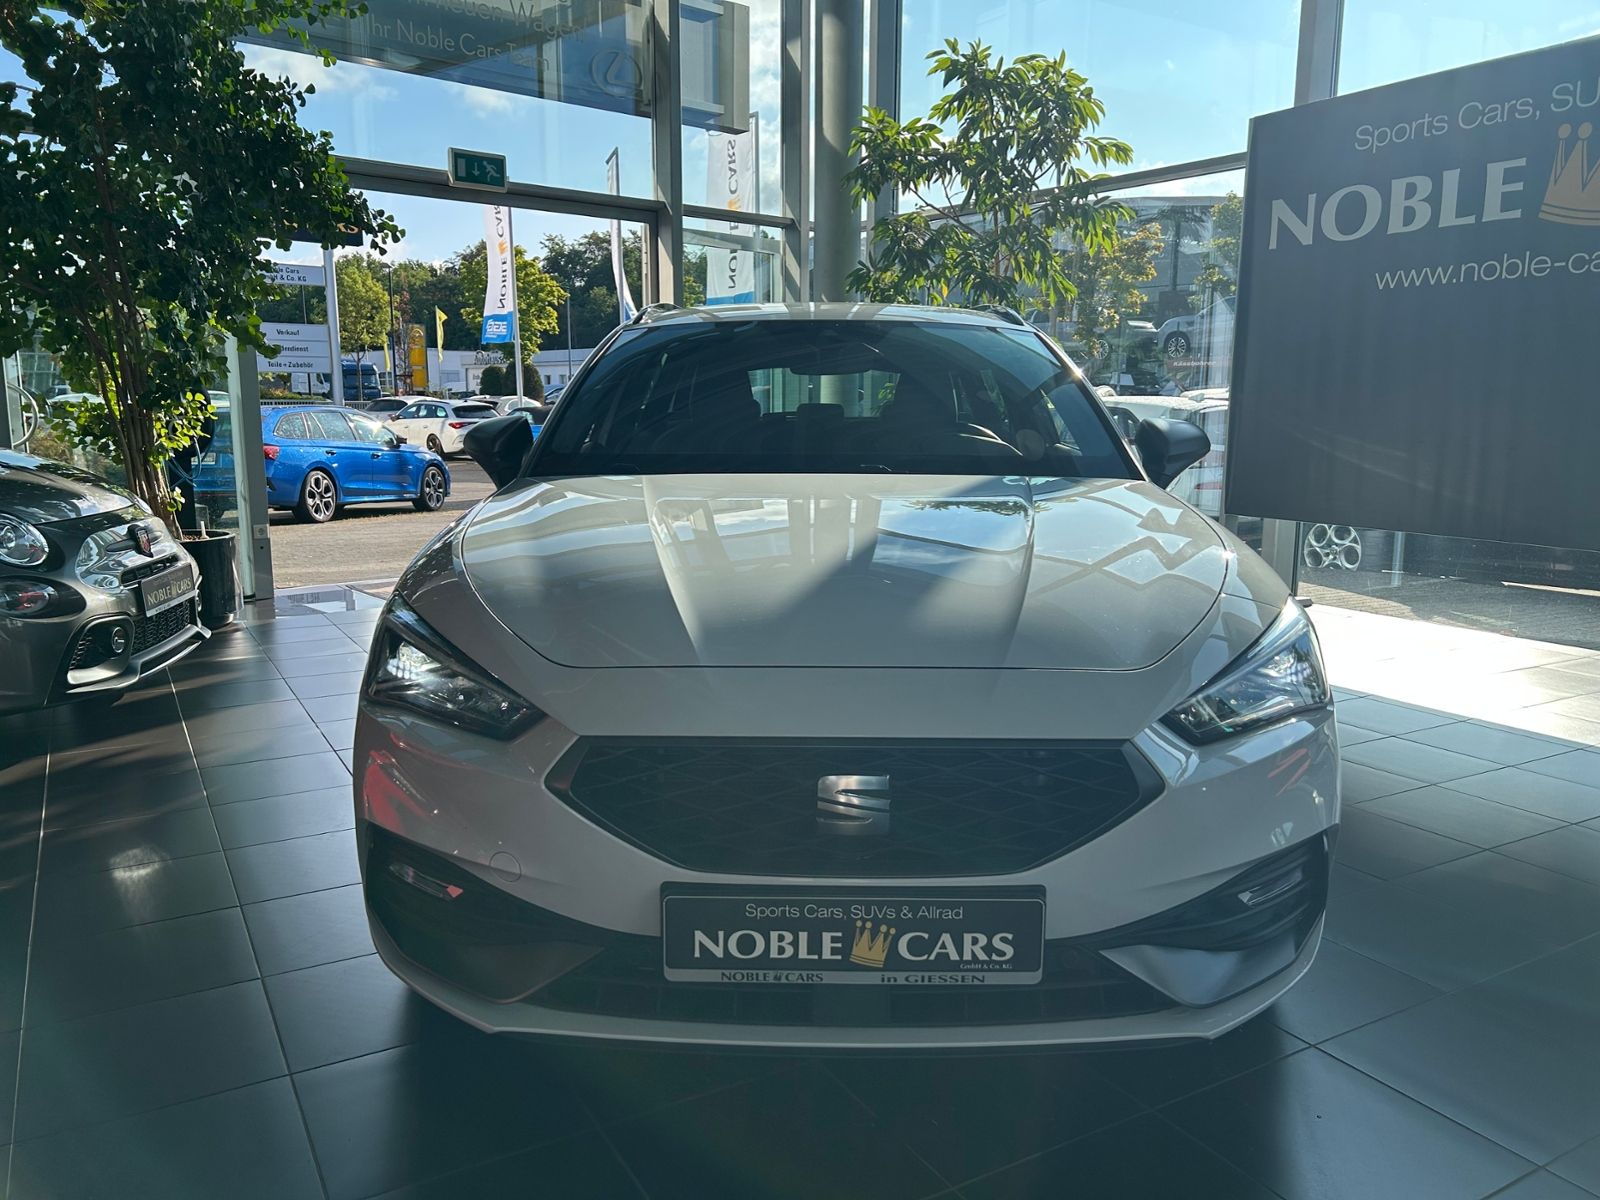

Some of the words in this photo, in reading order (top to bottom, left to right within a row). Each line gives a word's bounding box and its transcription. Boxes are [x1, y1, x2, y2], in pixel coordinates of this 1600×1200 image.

[396, 18, 456, 52] Noble
[459, 32, 502, 59] Cars
[1354, 113, 1449, 154] Sports
[1458, 96, 1541, 130] Cars,
[1268, 157, 1528, 250] NOBLE
[276, 328, 300, 336] Verkauf
[147, 586, 170, 606] NOBLE
[744, 903, 800, 921] Sports
[804, 903, 847, 921] Cars,
[850, 904, 897, 920] SUVs
[900, 905, 912, 920] &
[917, 904, 964, 921] Allrad
[693, 929, 843, 961] NOBLE
[897, 931, 1015, 962] CARS
[720, 971, 770, 982] NOBLE
[785, 972, 824, 983] CARS
[880, 974, 898, 984] in
[905, 974, 986, 984] GIESSEN
